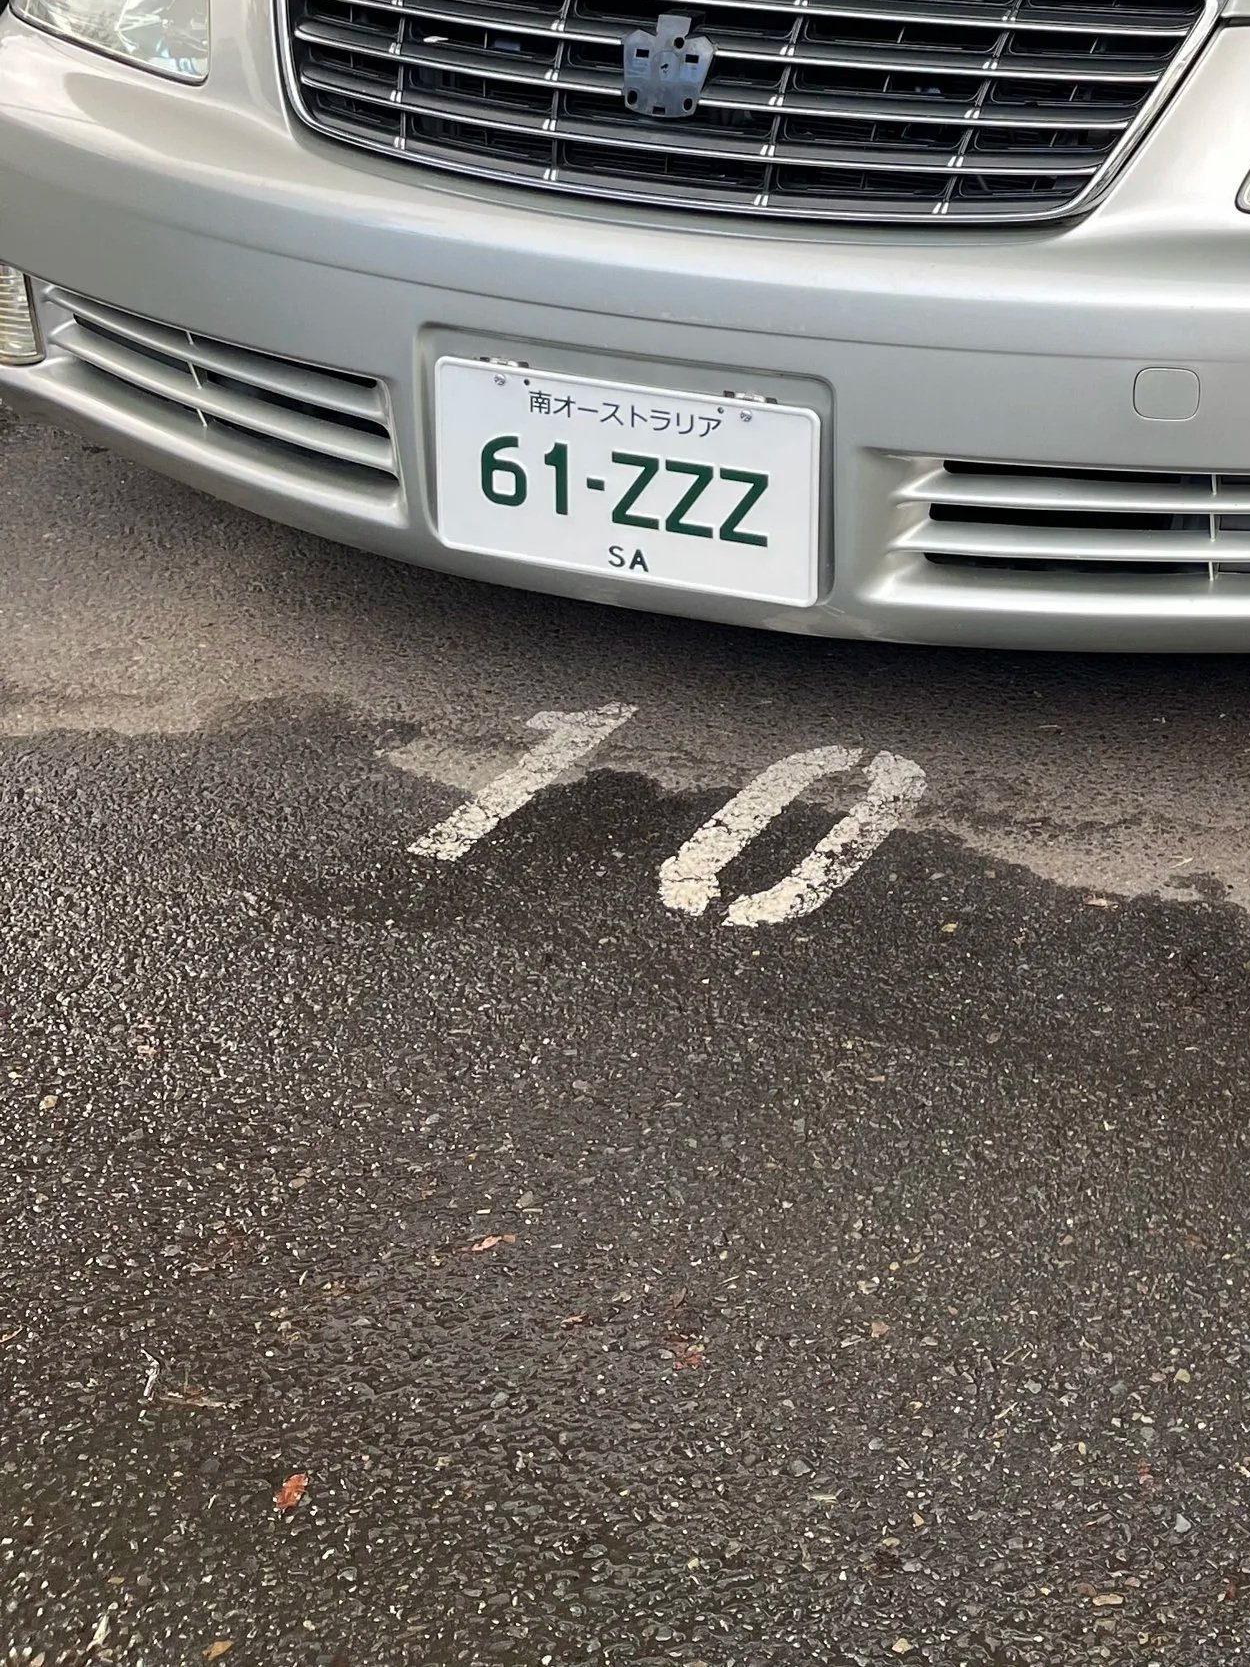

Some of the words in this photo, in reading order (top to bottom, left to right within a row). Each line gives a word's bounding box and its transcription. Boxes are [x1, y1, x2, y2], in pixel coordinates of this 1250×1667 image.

[529, 391, 722, 437] 南オーストラリア
[480, 435, 769, 547] 61-ZZZ
[608, 545, 649, 573] SA
[407, 701, 927, 927] 10
